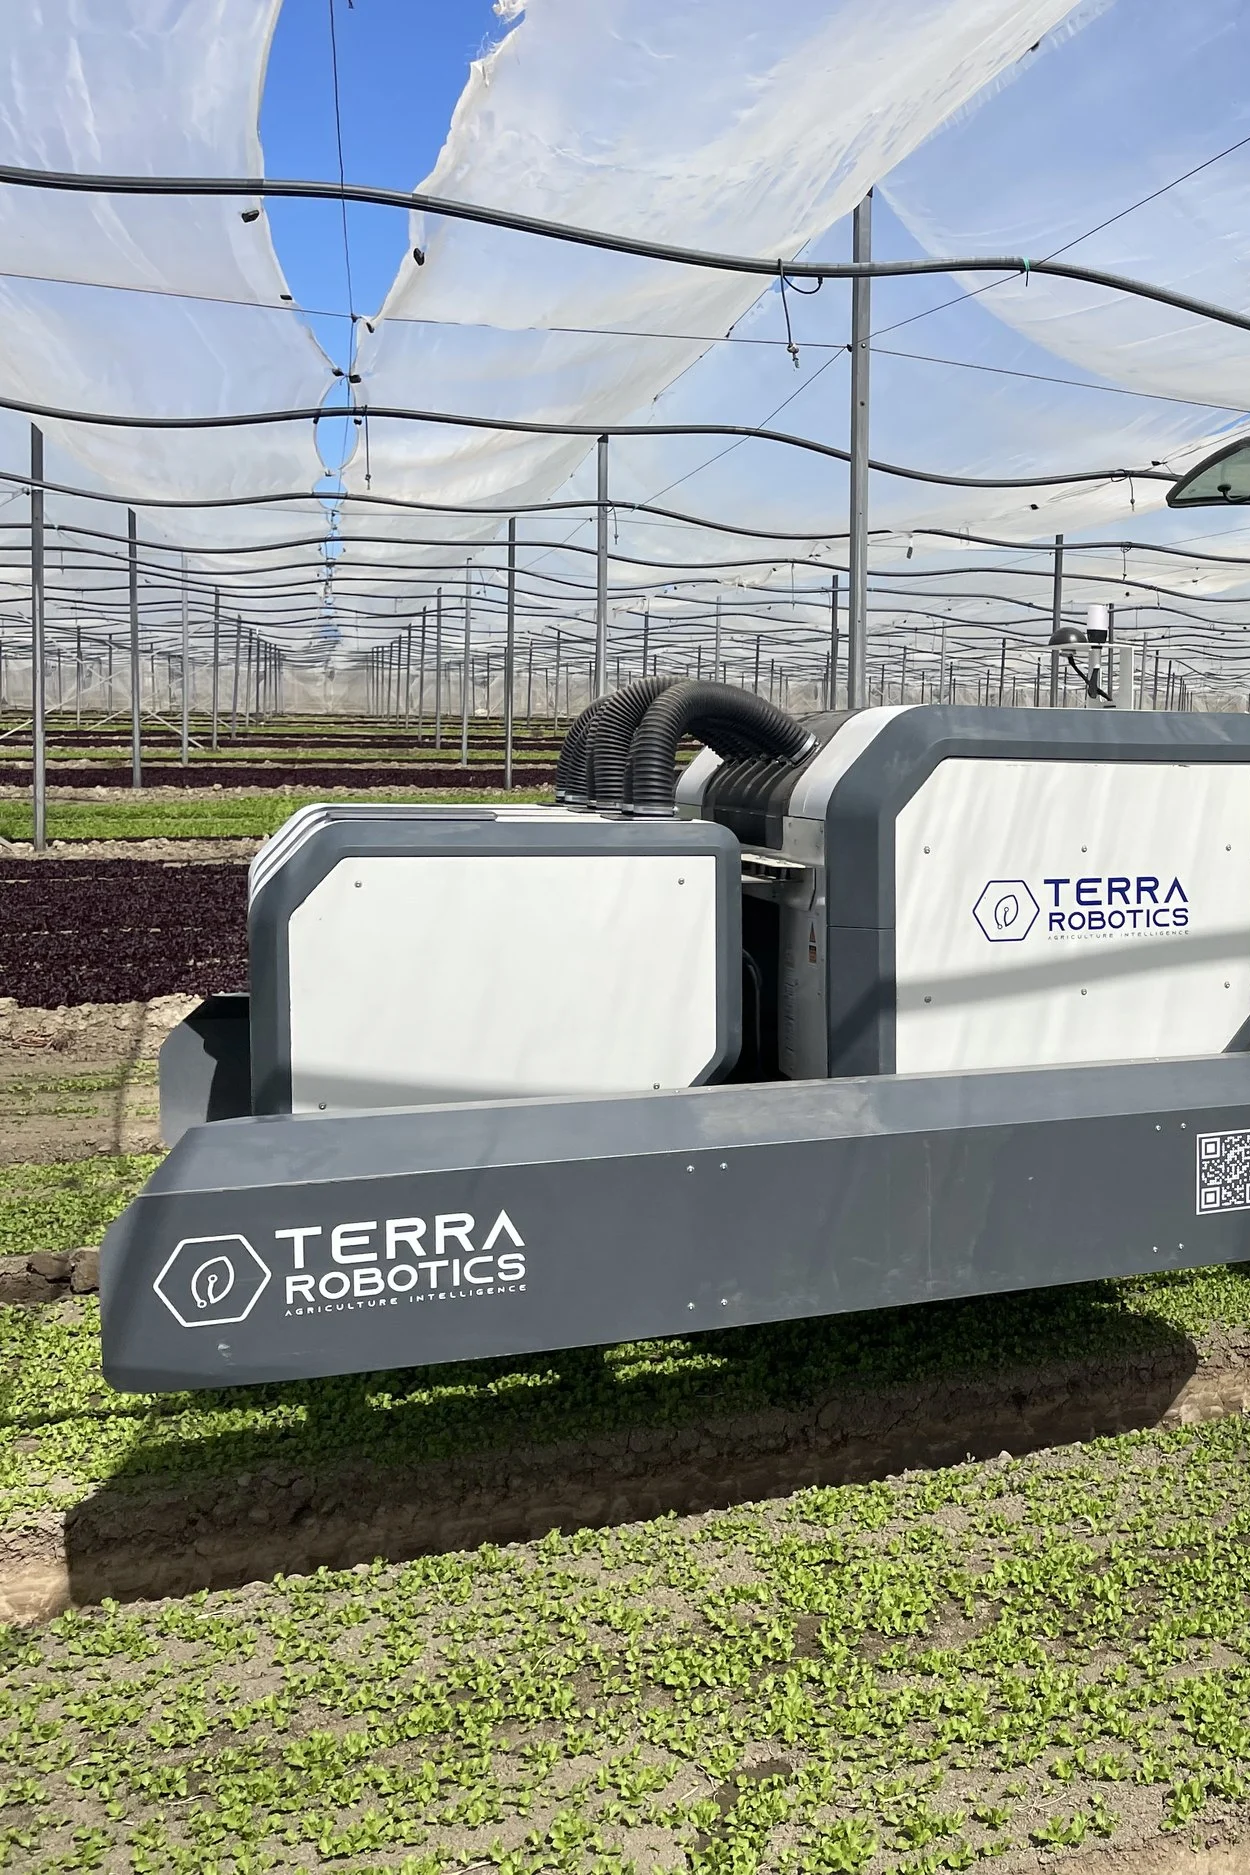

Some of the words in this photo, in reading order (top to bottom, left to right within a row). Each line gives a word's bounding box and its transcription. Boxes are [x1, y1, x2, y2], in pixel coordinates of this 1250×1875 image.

[1043, 876, 1189, 907] TERRA
[1047, 933, 1114, 941] AGRICULTURE
[1120, 929, 1190, 937] INTELLIGENCE
[1048, 907, 1189, 932] ROBOTICS
[274, 1209, 526, 1269] TERRA
[285, 1253, 526, 1305] ROBOTICS
[284, 1297, 398, 1317] AGRICULTURE
[409, 1284, 527, 1303] INTELLIGENCE
